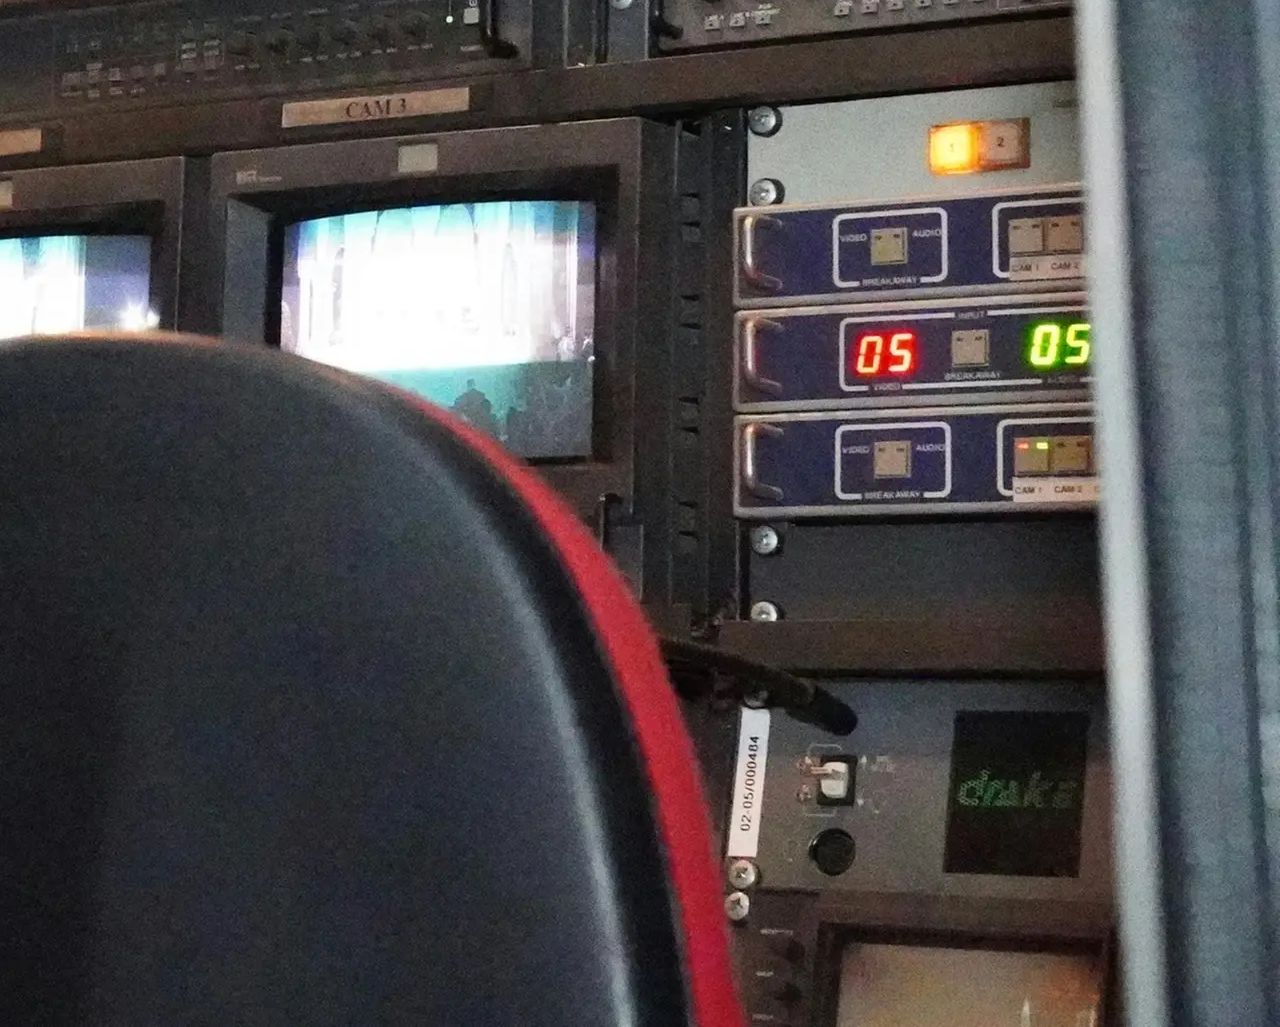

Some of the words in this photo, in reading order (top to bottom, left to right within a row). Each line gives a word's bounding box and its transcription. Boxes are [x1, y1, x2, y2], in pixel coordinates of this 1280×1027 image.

[346, 99, 392, 119] CAM
[396, 98, 407, 113] 3
[997, 136, 1004, 147] 2
[912, 228, 942, 238] AUDIO
[957, 311, 985, 320] INPUT
[1030, 323, 1091, 366] 05
[856, 332, 913, 374] 05
[842, 445, 870, 454] VIDEO
[916, 443, 946, 452] AUDIO
[1014, 486, 1035, 494] CAM
[1054, 485, 1075, 494] CAM
[864, 490, 921, 499] BREAKAWAY
[739, 735, 760, 832] 02-05/000484
